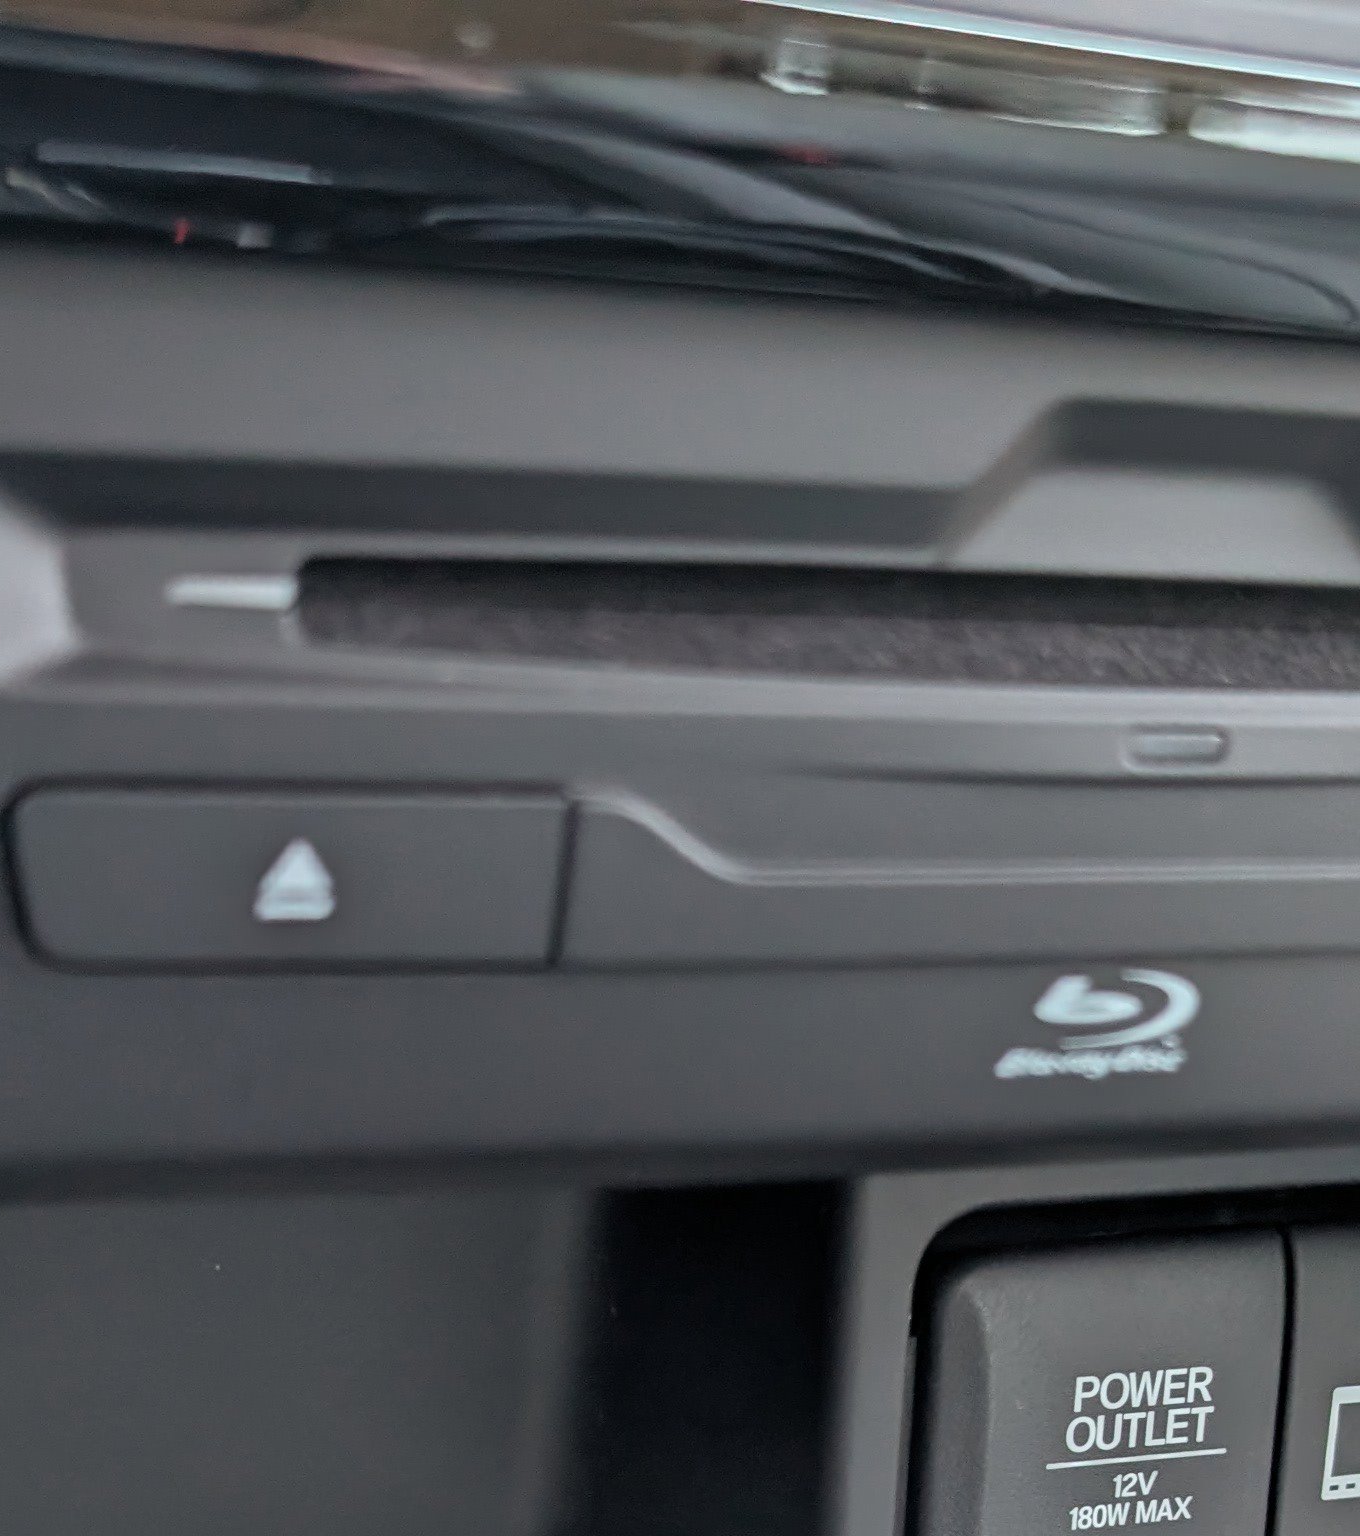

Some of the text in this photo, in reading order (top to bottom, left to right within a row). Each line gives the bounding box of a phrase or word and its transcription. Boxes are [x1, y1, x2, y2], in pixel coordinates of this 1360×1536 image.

[1073, 1366, 1213, 1413] POWER
[1065, 1406, 1215, 1453] OUTLET
[1112, 1471, 1159, 1499] 12V
[1068, 1496, 1194, 1531] 180W MAX
